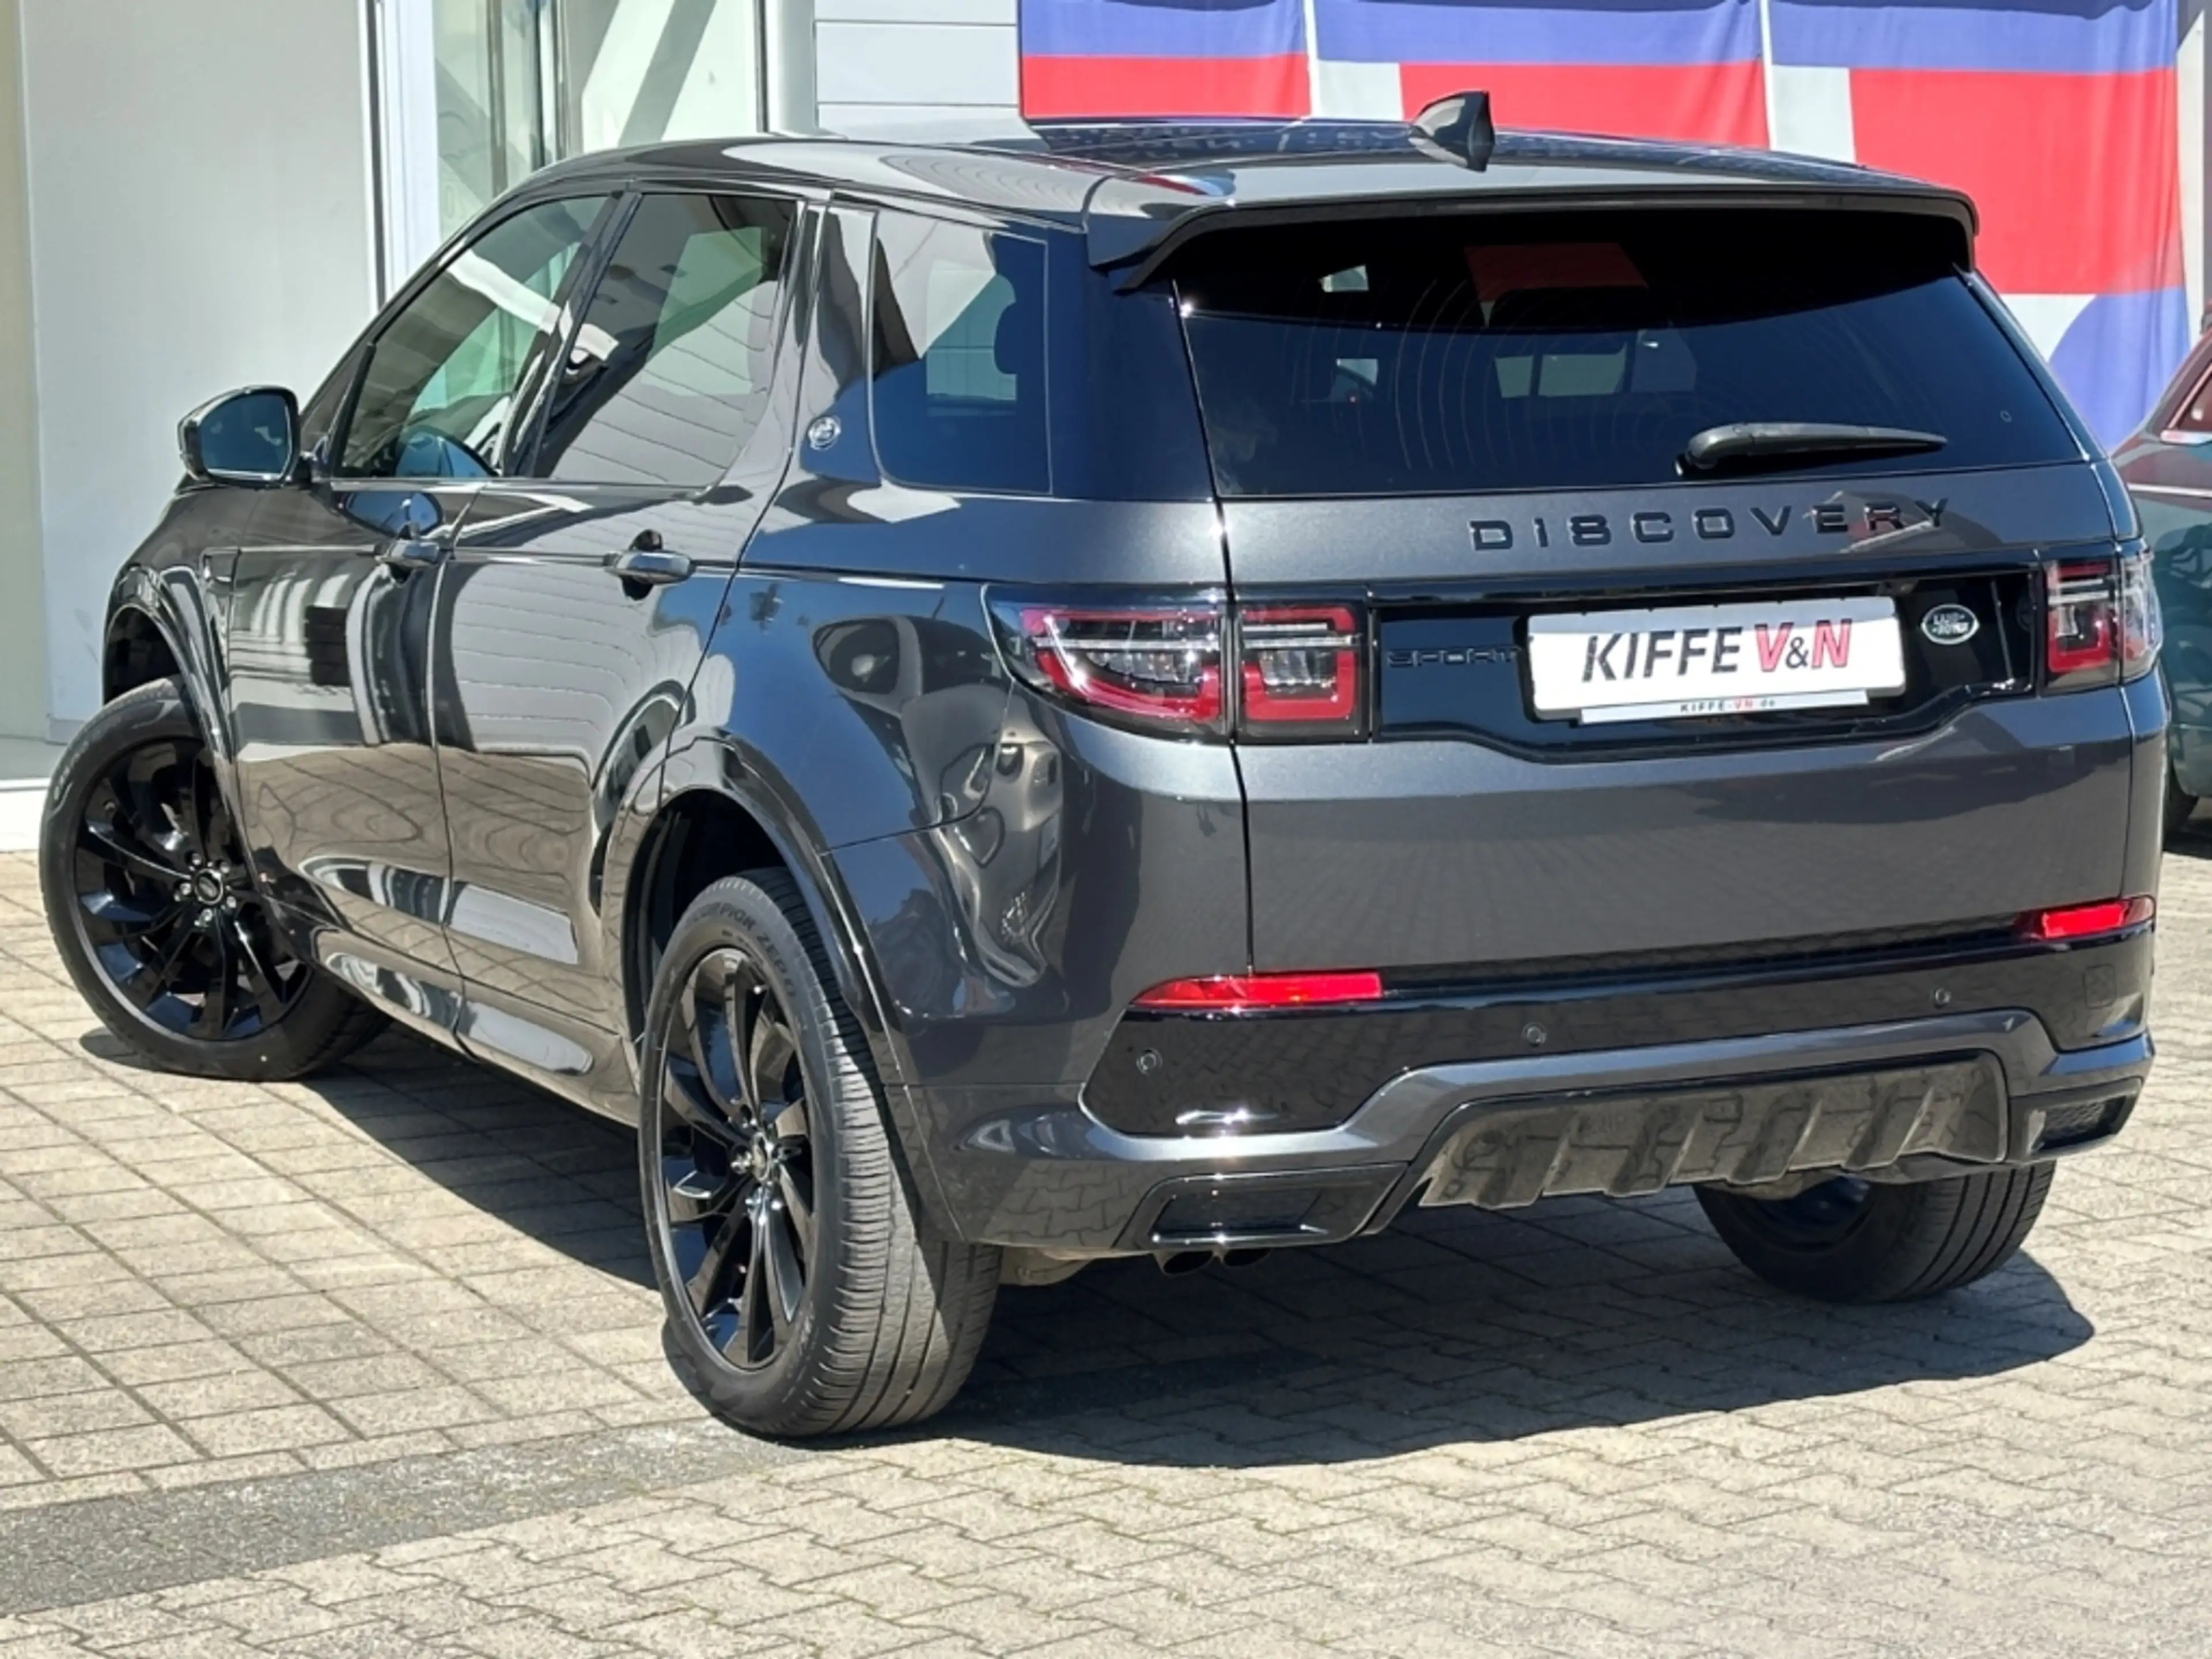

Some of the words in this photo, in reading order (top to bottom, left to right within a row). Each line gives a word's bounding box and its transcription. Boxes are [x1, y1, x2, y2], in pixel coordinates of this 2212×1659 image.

[1469, 498, 1949, 551] DISCOVERY
[1582, 626, 1744, 683] KIFFE
[1753, 618, 1853, 673] V&N
